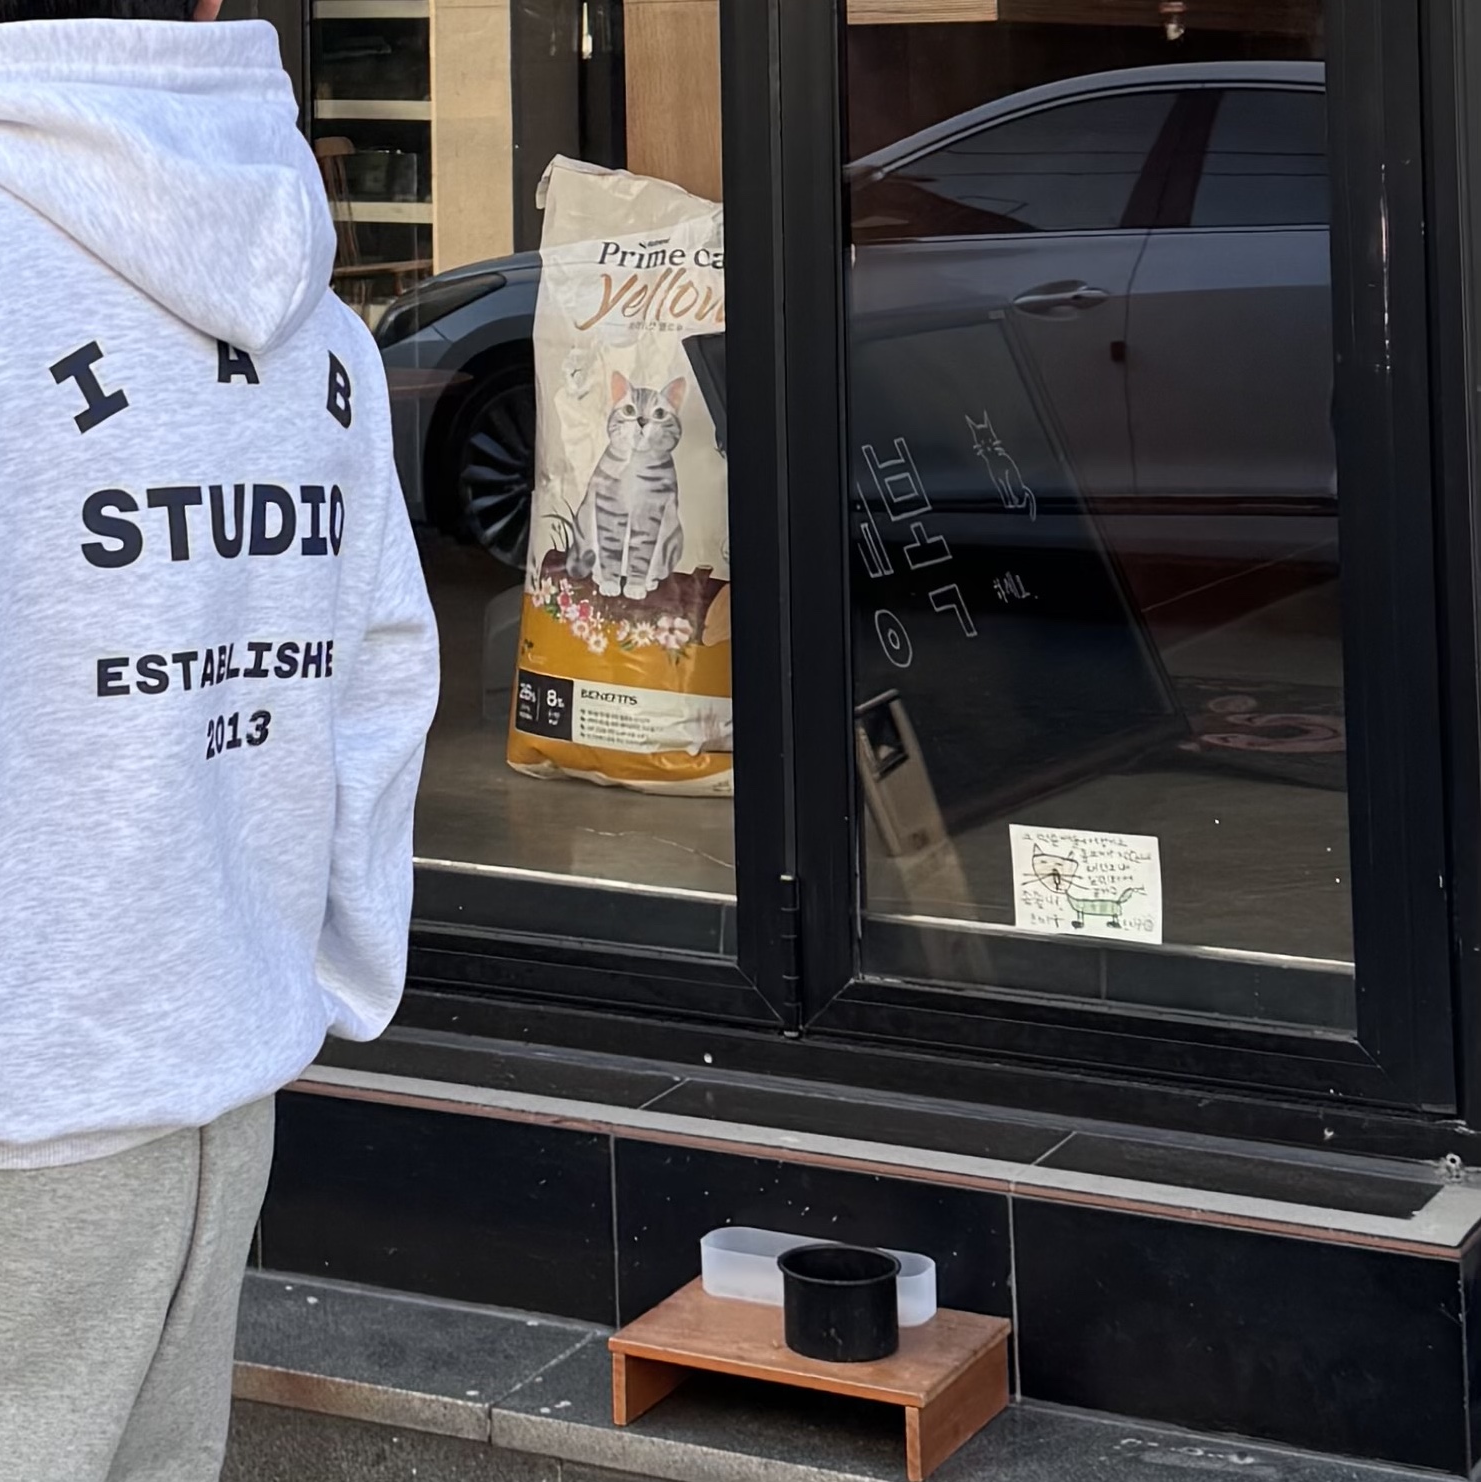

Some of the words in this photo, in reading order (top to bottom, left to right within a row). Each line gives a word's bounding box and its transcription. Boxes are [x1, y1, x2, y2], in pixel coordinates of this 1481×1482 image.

[598, 241, 686, 269] Prime
[81, 483, 345, 569] STUDIO
[206, 710, 272, 760] 2013
